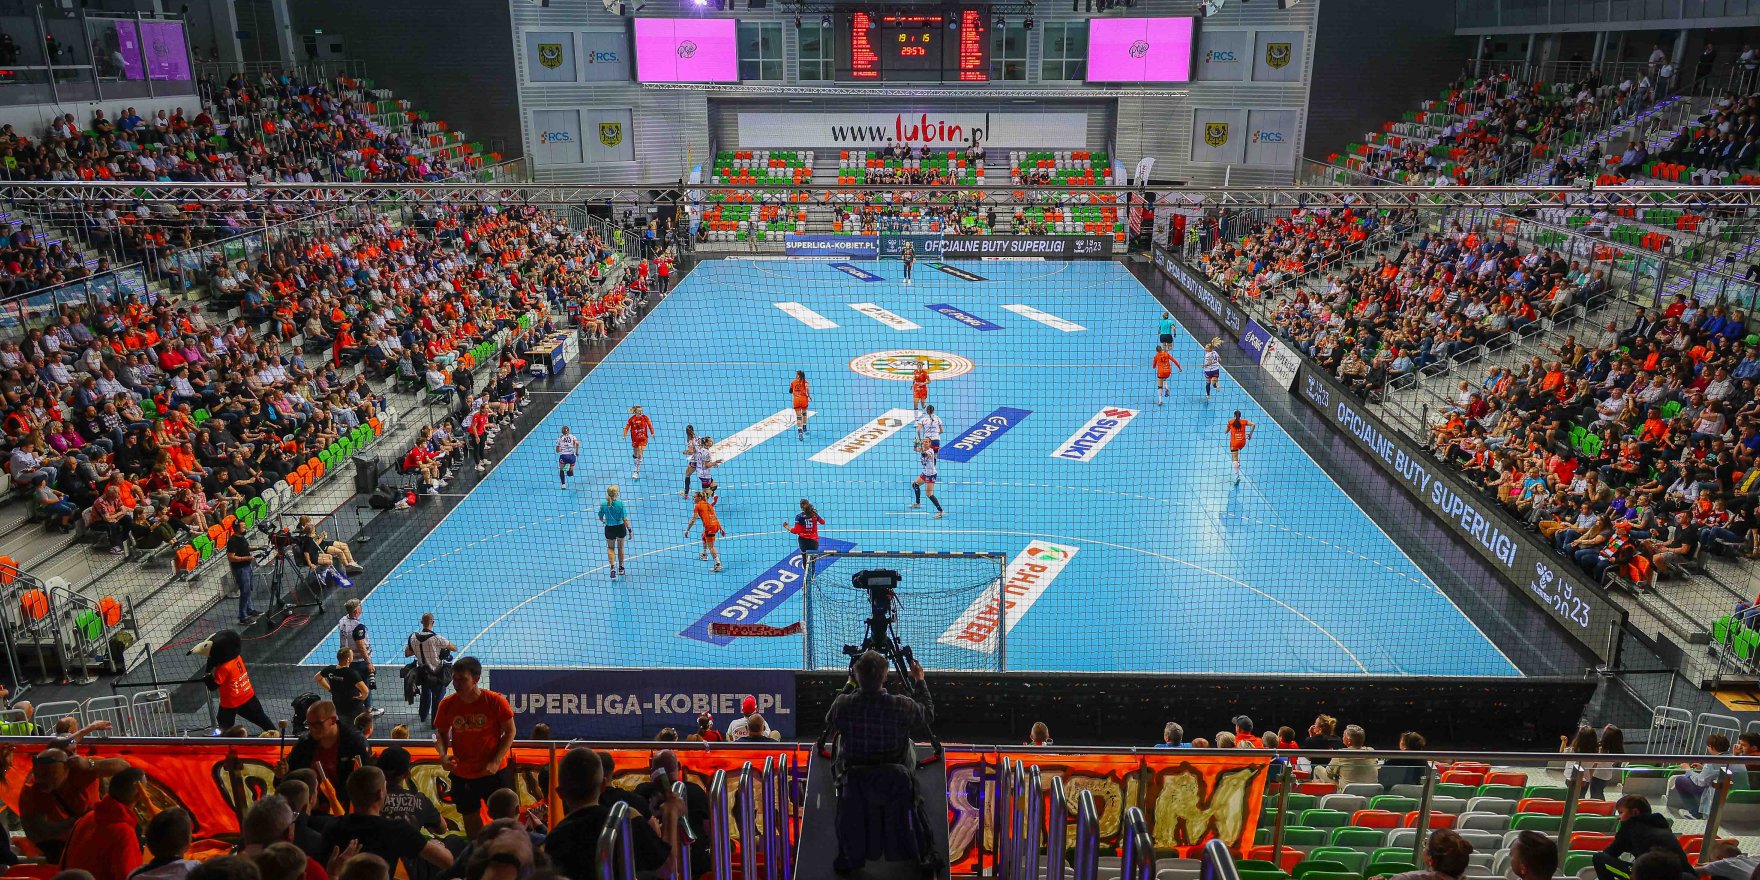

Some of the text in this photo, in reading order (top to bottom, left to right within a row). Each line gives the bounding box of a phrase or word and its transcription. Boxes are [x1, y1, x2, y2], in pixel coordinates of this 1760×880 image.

[898, 33, 906, 42] 19
[922, 33, 930, 42] 15
[831, 112, 990, 145] www.lubin.pl
[786, 241, 875, 249] SUPERLIGA-KOBIET.PL
[925, 240, 980, 252] OFICJALNE
[982, 240, 1009, 252] BUTY
[1011, 240, 1065, 253] SUPERLIGI
[1060, 418, 1118, 459] SUZUKI
[1337, 402, 1518, 568] OFICJALNE BUTY SUPERLIGI
[720, 569, 800, 621] PGNiG
